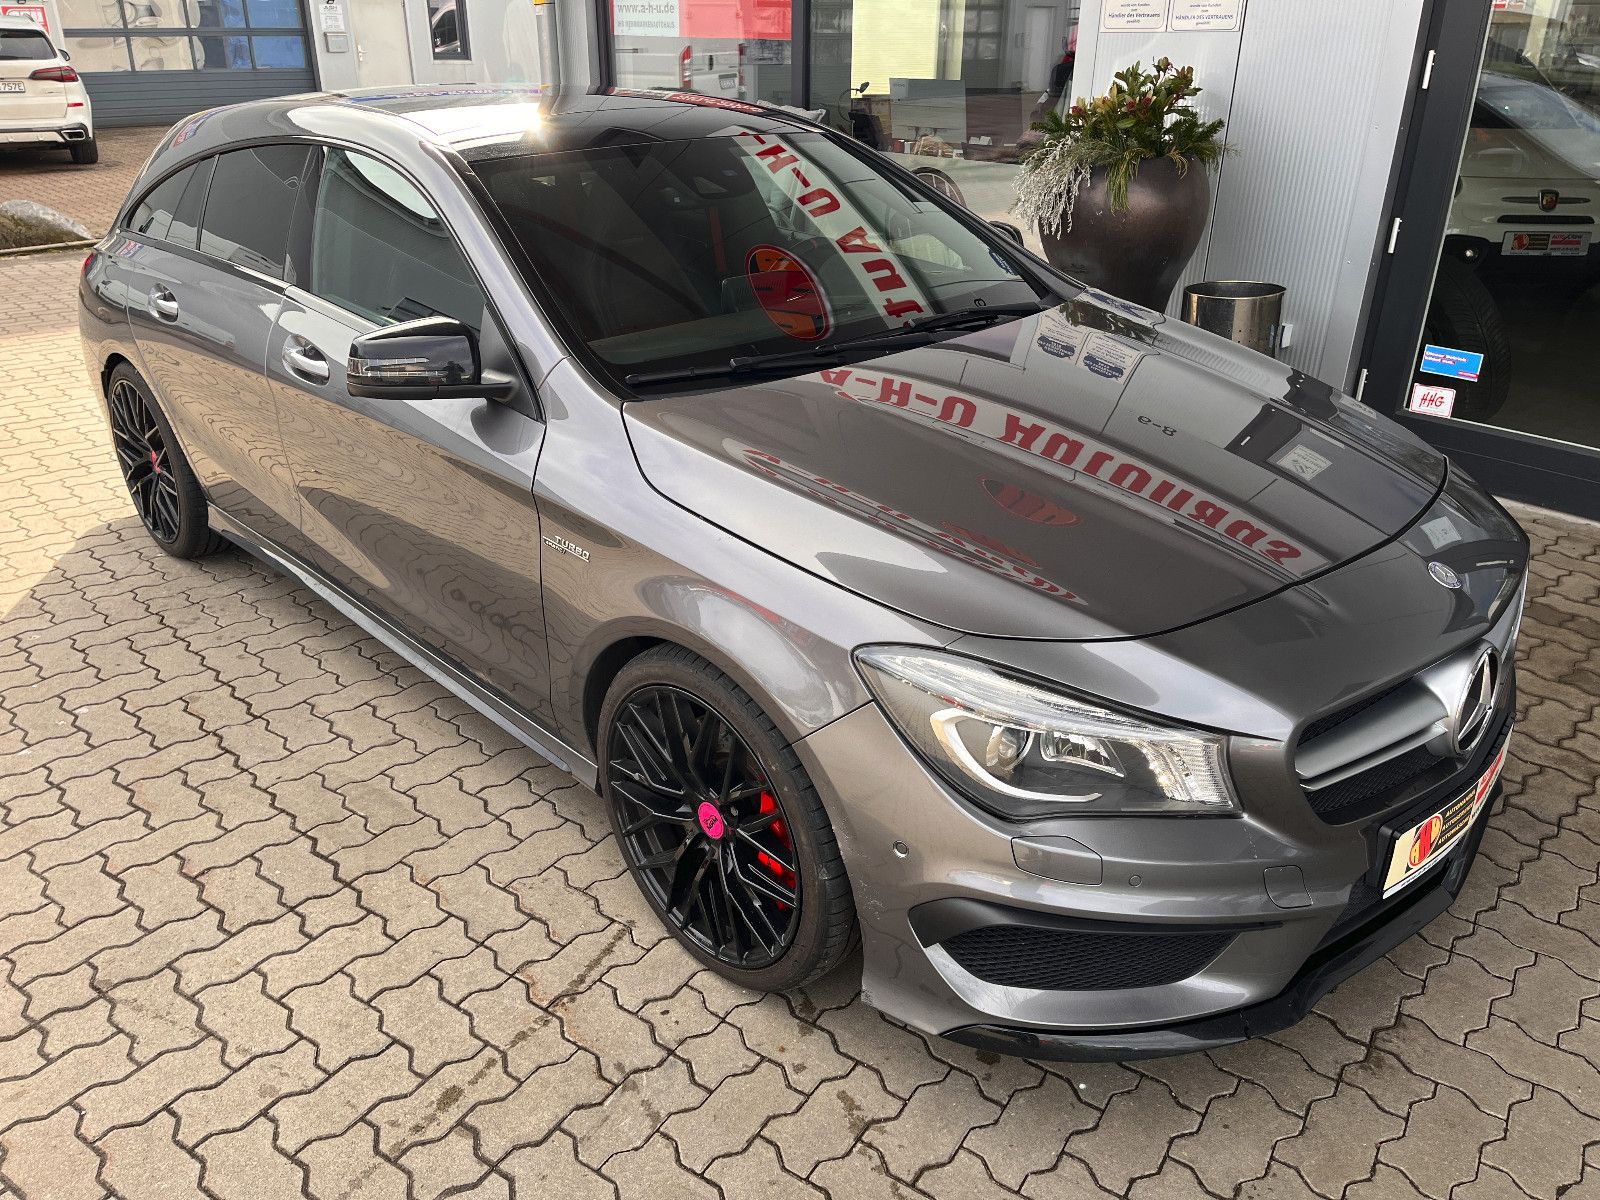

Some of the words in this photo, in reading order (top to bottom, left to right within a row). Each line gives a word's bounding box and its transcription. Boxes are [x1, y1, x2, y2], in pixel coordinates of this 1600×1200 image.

[617, 2, 675, 14] www.a-h-u.de
[1418, 391, 1445, 408] HHG
[554, 535, 590, 560] TURBO
